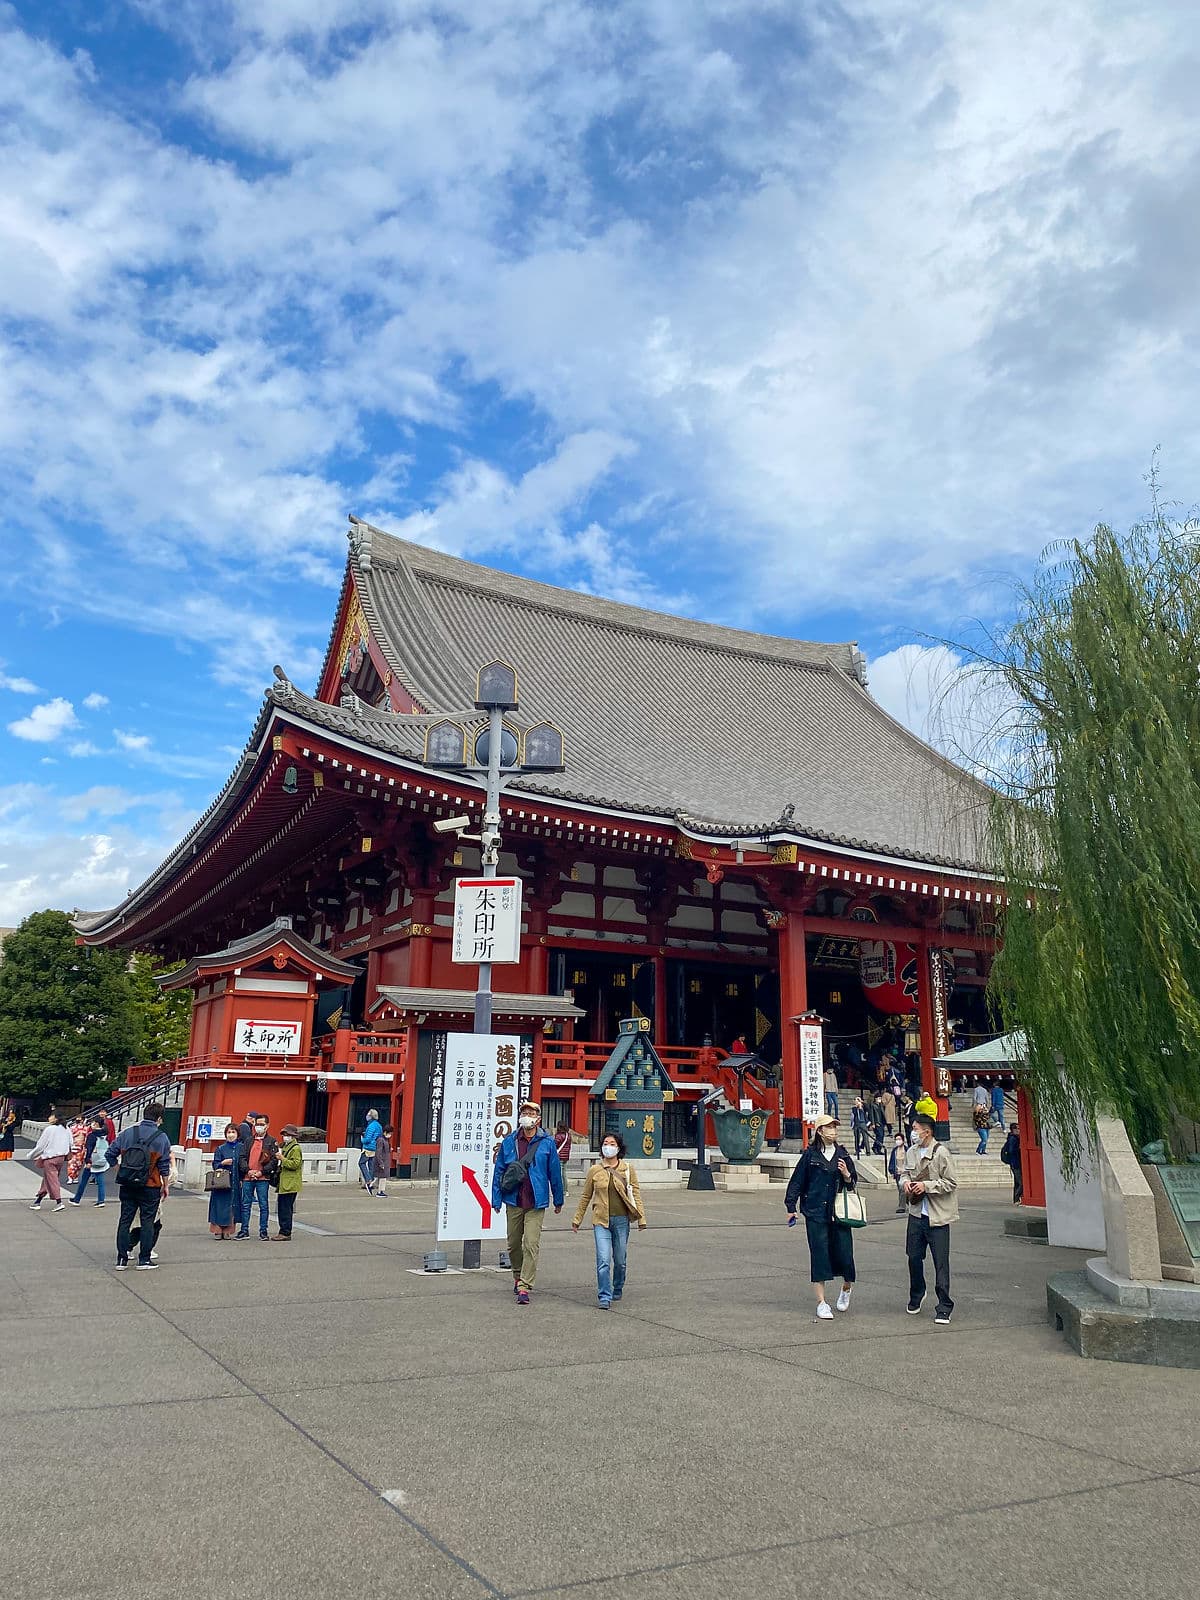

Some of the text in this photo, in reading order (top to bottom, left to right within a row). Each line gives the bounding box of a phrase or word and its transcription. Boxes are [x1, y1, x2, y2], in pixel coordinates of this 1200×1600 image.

[472, 888, 496, 959] 朱印所
[242, 1027, 293, 1049] 朱印所
